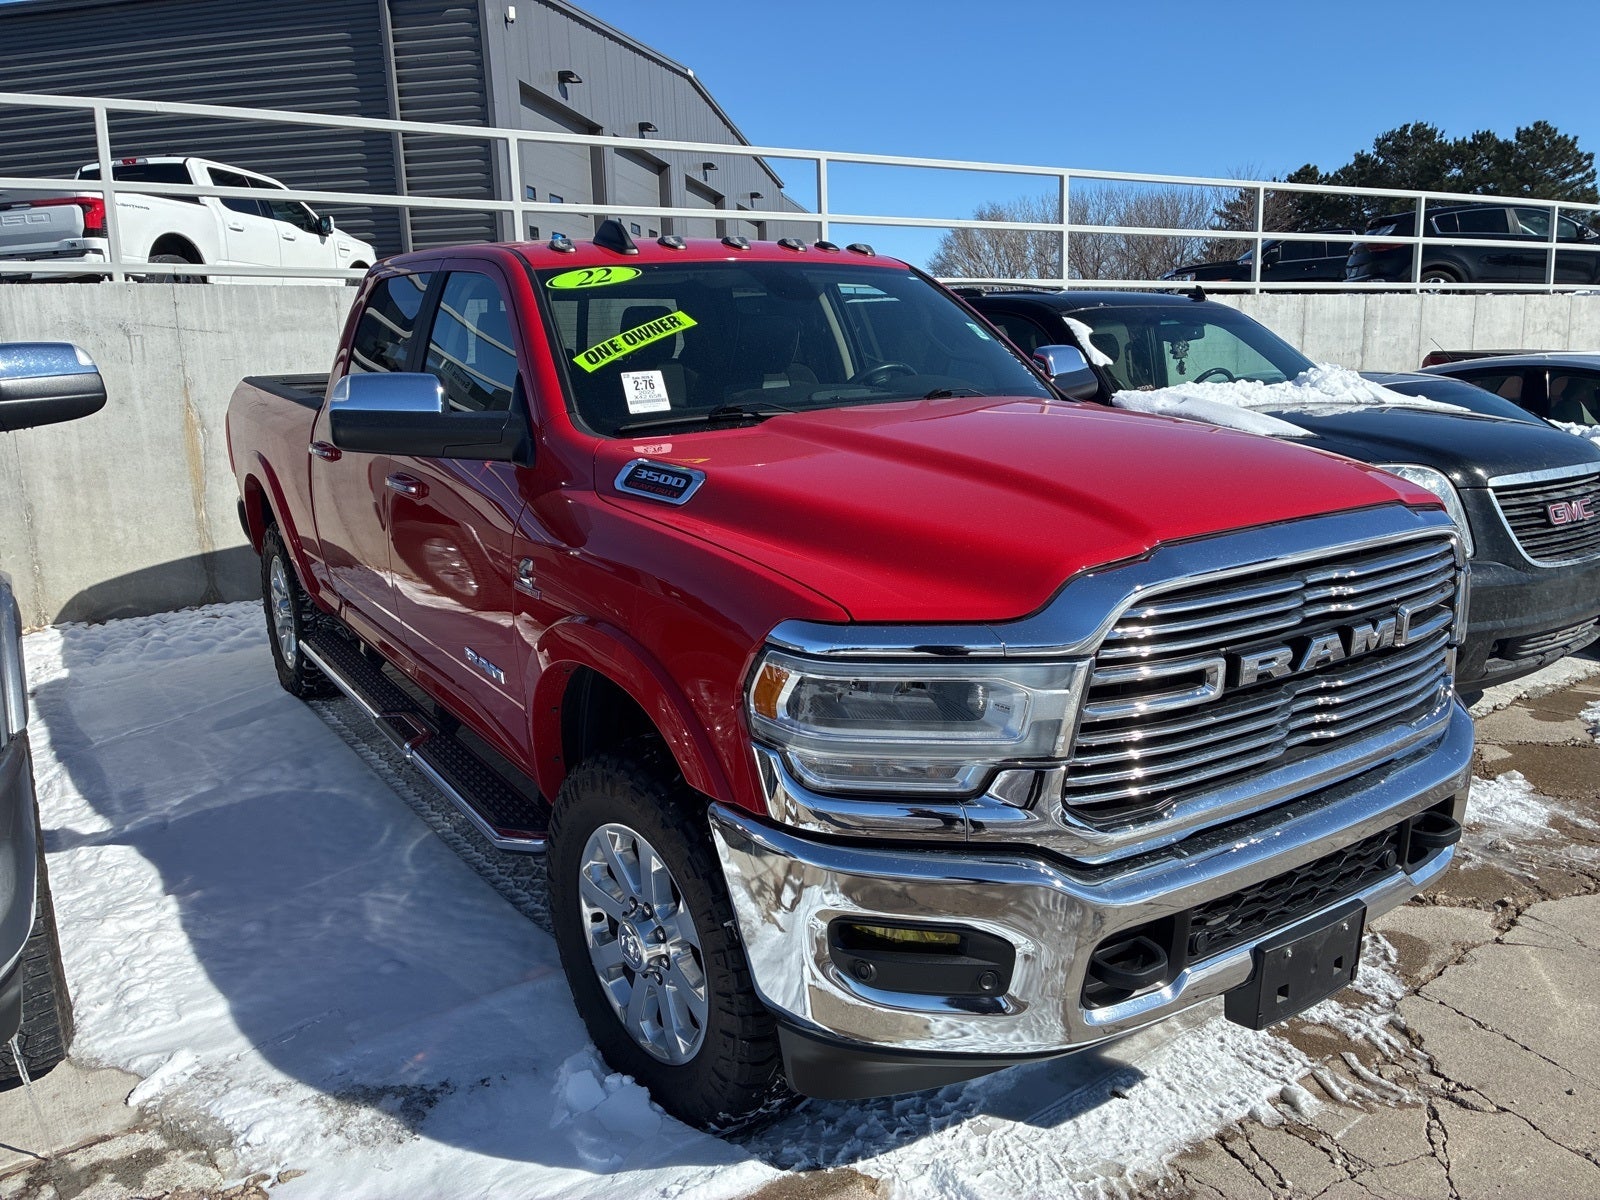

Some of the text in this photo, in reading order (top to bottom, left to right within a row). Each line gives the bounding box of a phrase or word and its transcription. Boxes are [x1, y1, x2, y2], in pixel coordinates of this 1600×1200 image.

[0, 212, 51, 227] 50
[575, 267, 613, 286] 22
[583, 315, 683, 366] ONE OWNER
[633, 379, 655, 391] 2:76
[634, 468, 687, 488] 3500
[1548, 497, 1596, 525] GMC
[1239, 617, 1396, 687] RAM
